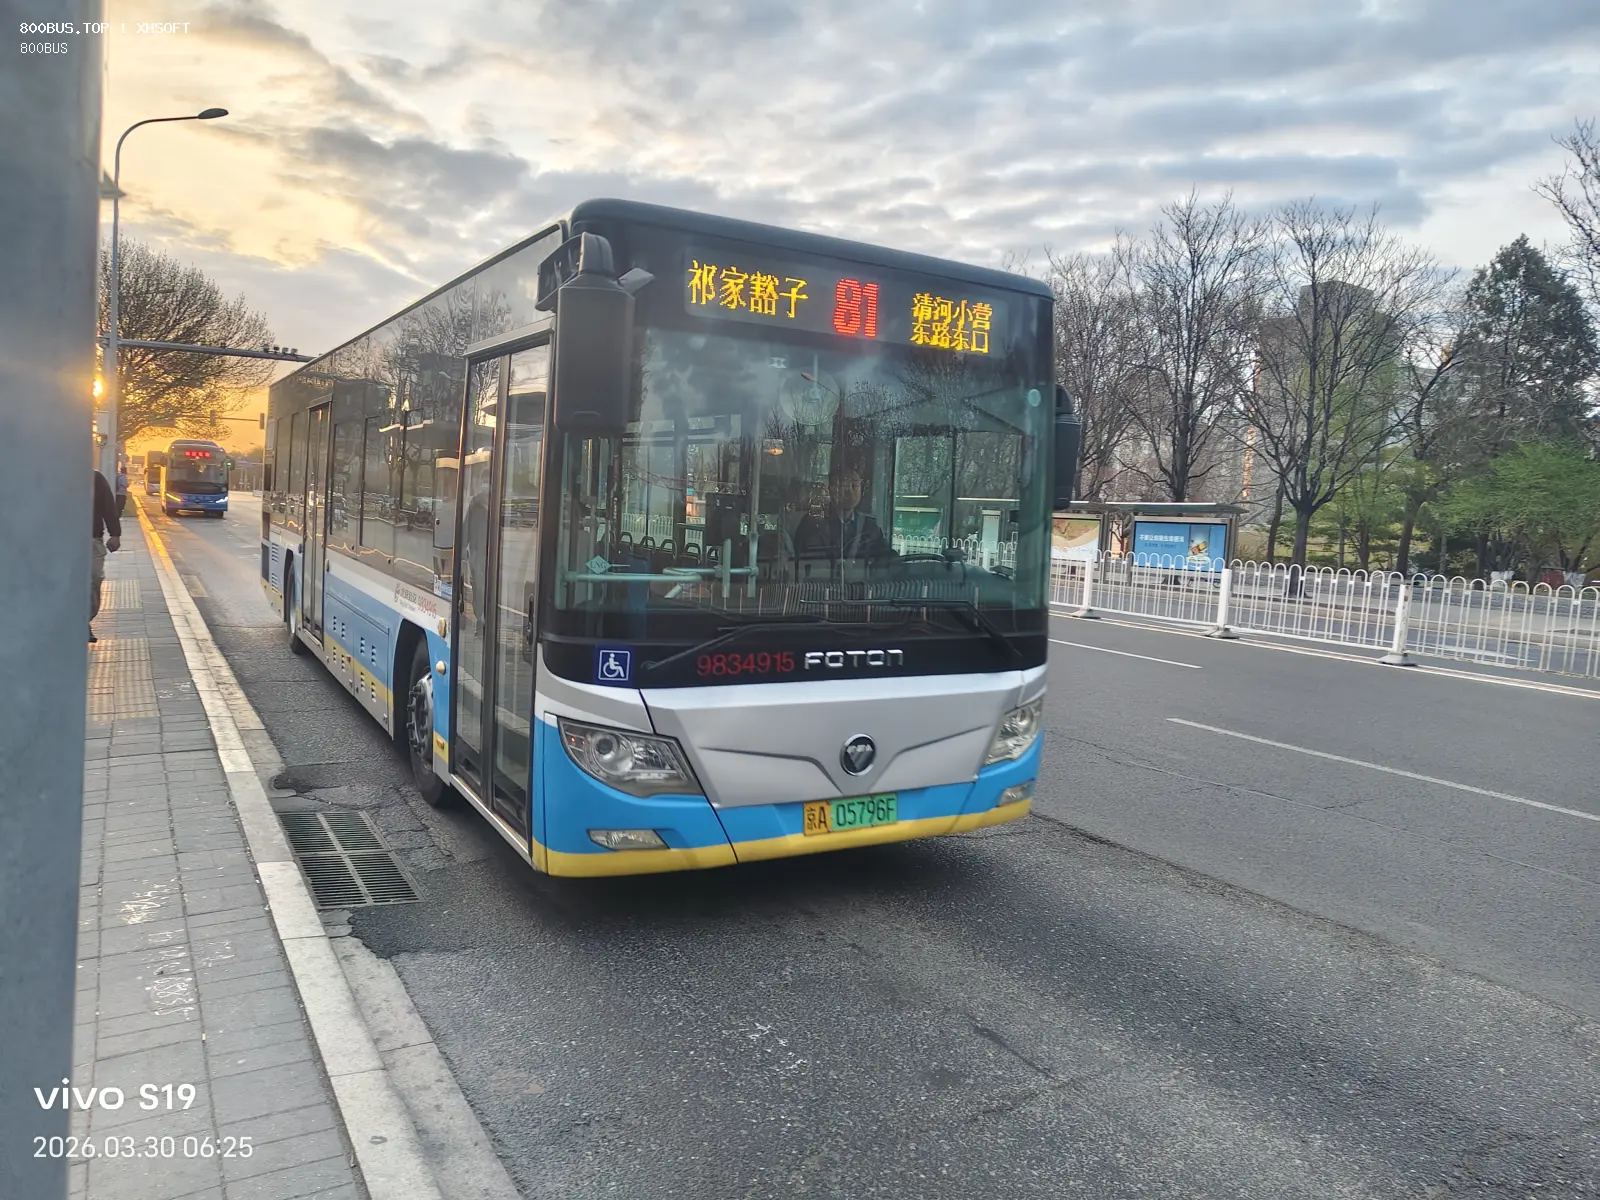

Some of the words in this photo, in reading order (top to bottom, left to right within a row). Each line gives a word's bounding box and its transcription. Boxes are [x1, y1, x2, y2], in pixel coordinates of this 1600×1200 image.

[688, 260, 808, 318] 祁家豁子
[831, 278, 879, 338] 81
[910, 292, 993, 331] 清河小营
[909, 321, 989, 354] 东路东口
[696, 651, 795, 676] 9834915
[804, 649, 904, 670] FOTON
